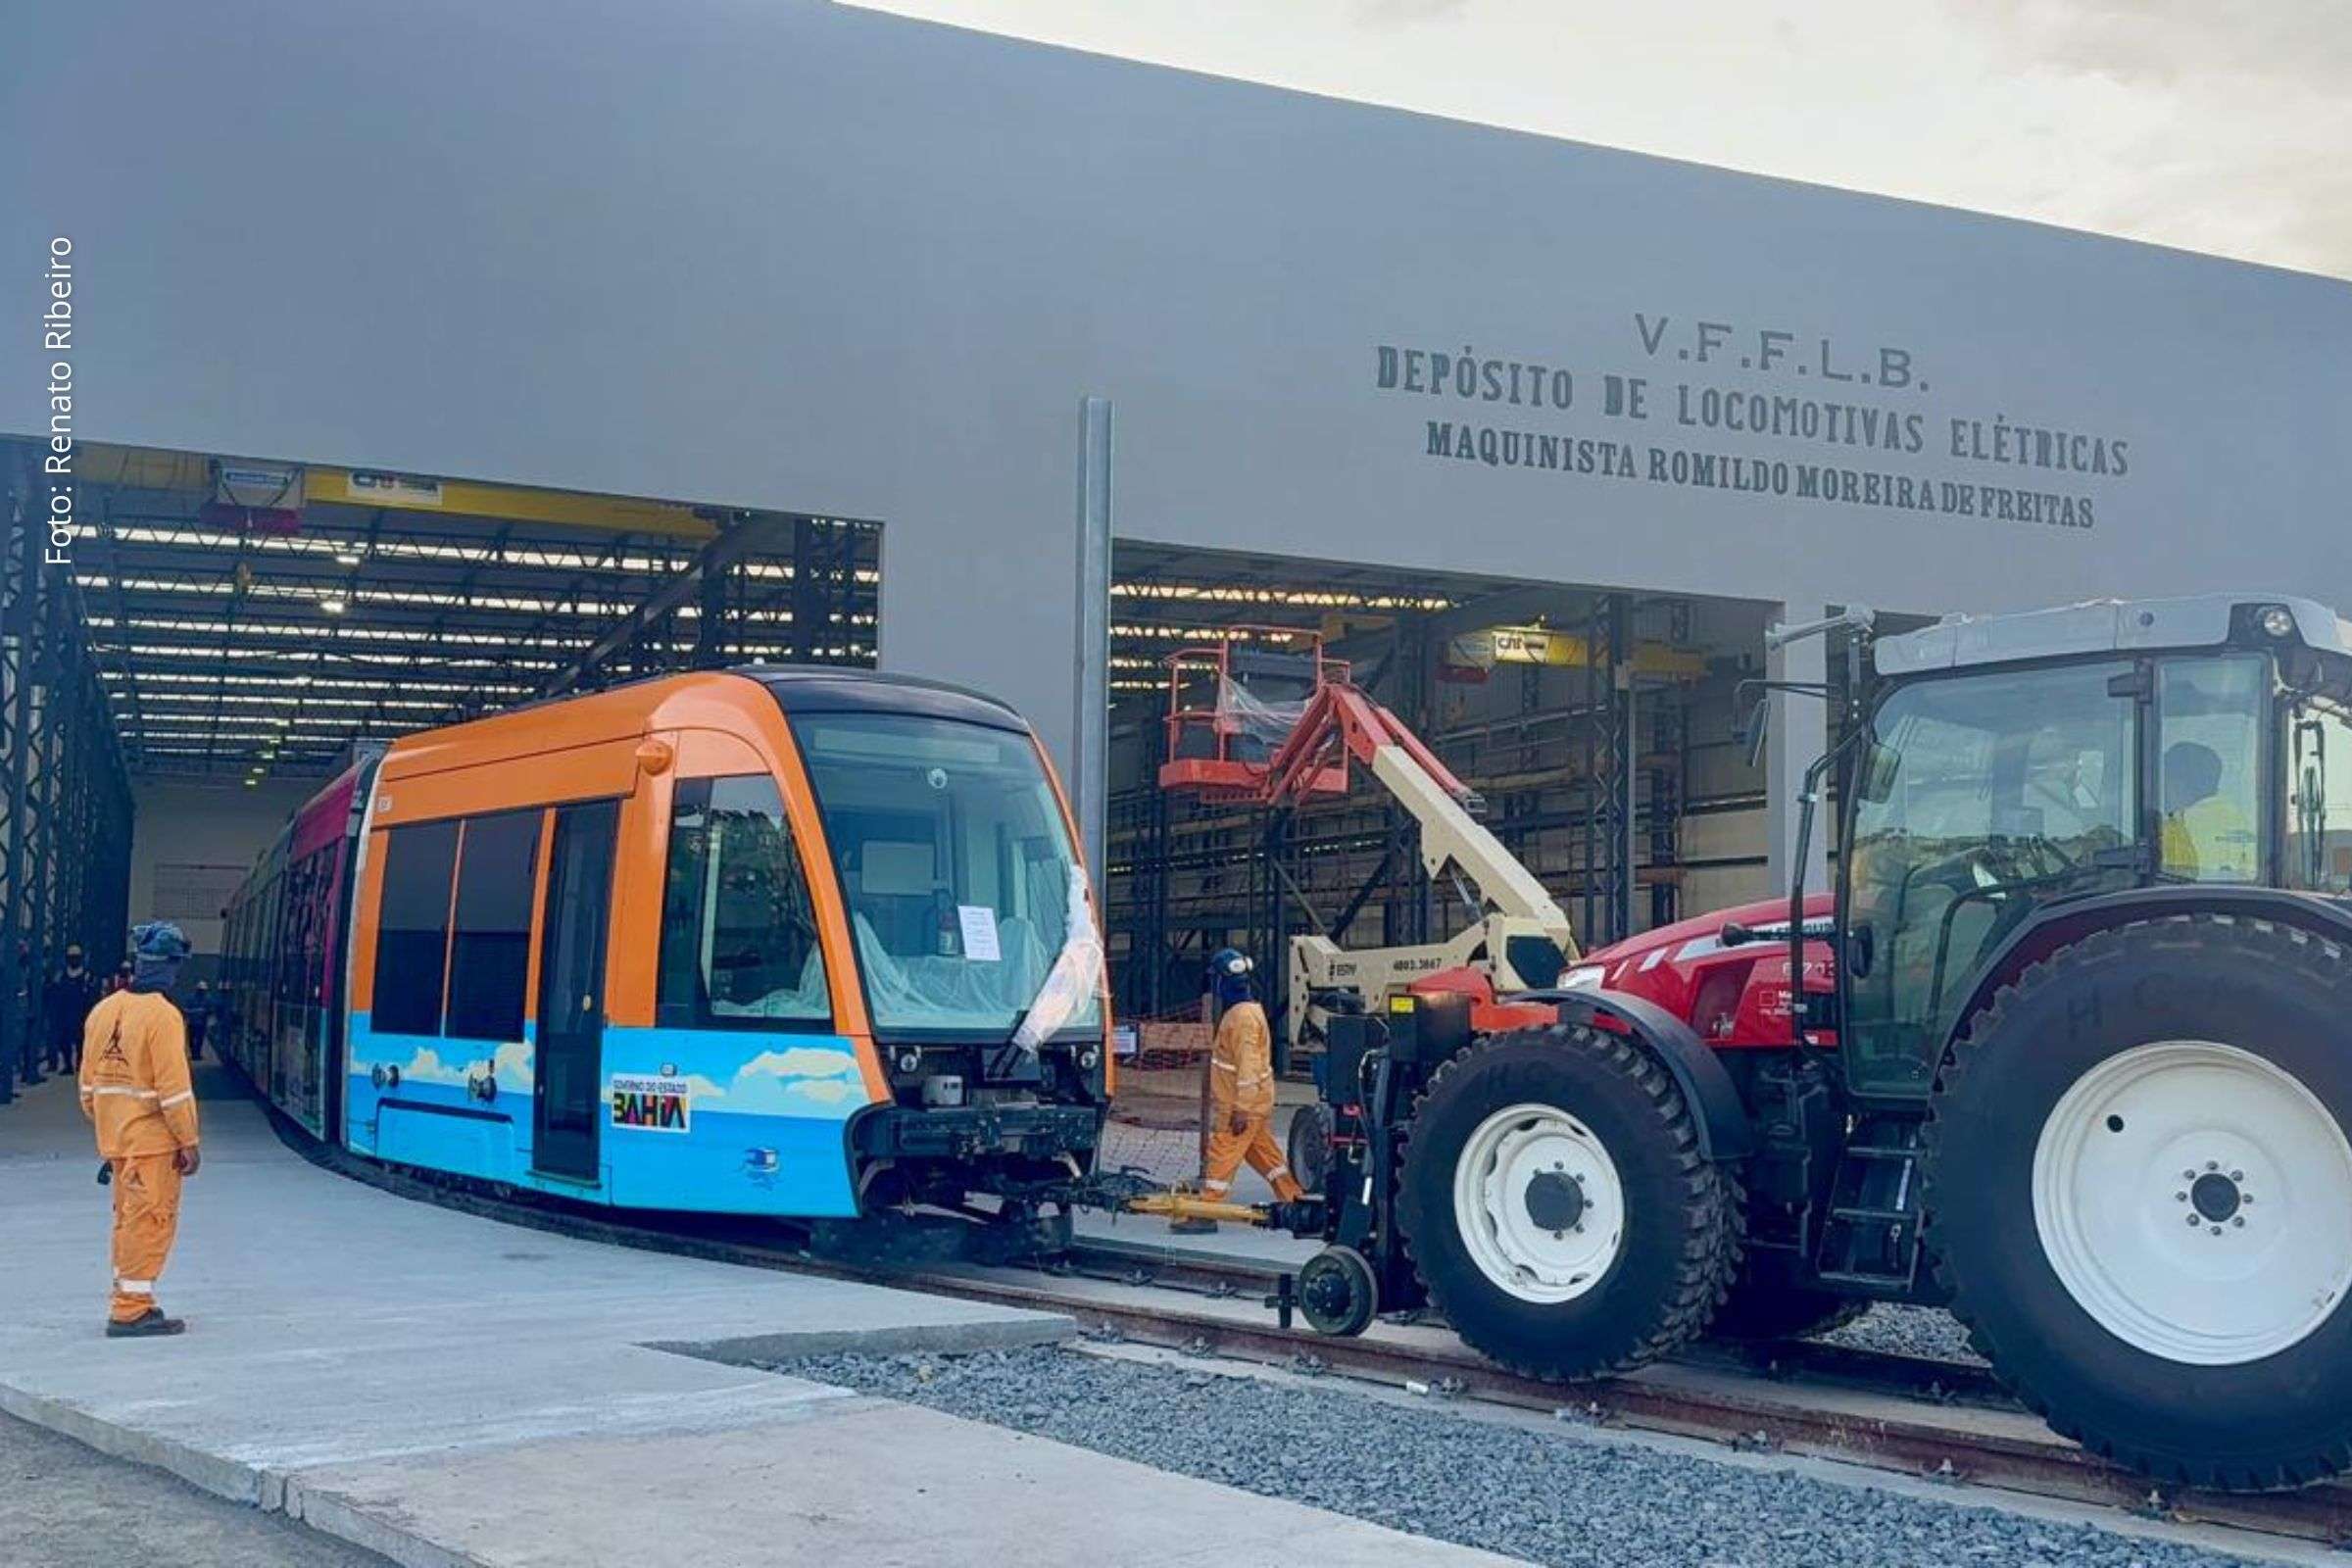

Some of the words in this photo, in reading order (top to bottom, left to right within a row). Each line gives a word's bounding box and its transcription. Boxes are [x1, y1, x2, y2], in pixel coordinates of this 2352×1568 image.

[1376, 345, 1574, 411] DEPÓSITO
[1604, 374, 1648, 419] DE
[1677, 383, 1924, 455] LOCOMOTIVAS
[1949, 413, 2130, 476] ELÉTRICAS
[1426, 420, 1637, 477] MAQUINISTA
[1647, 447, 1789, 496] ROMILDO
[1794, 465, 1936, 512] MOREIRA
[1941, 481, 1975, 516] DE
[1979, 485, 2095, 529] FREITAS
